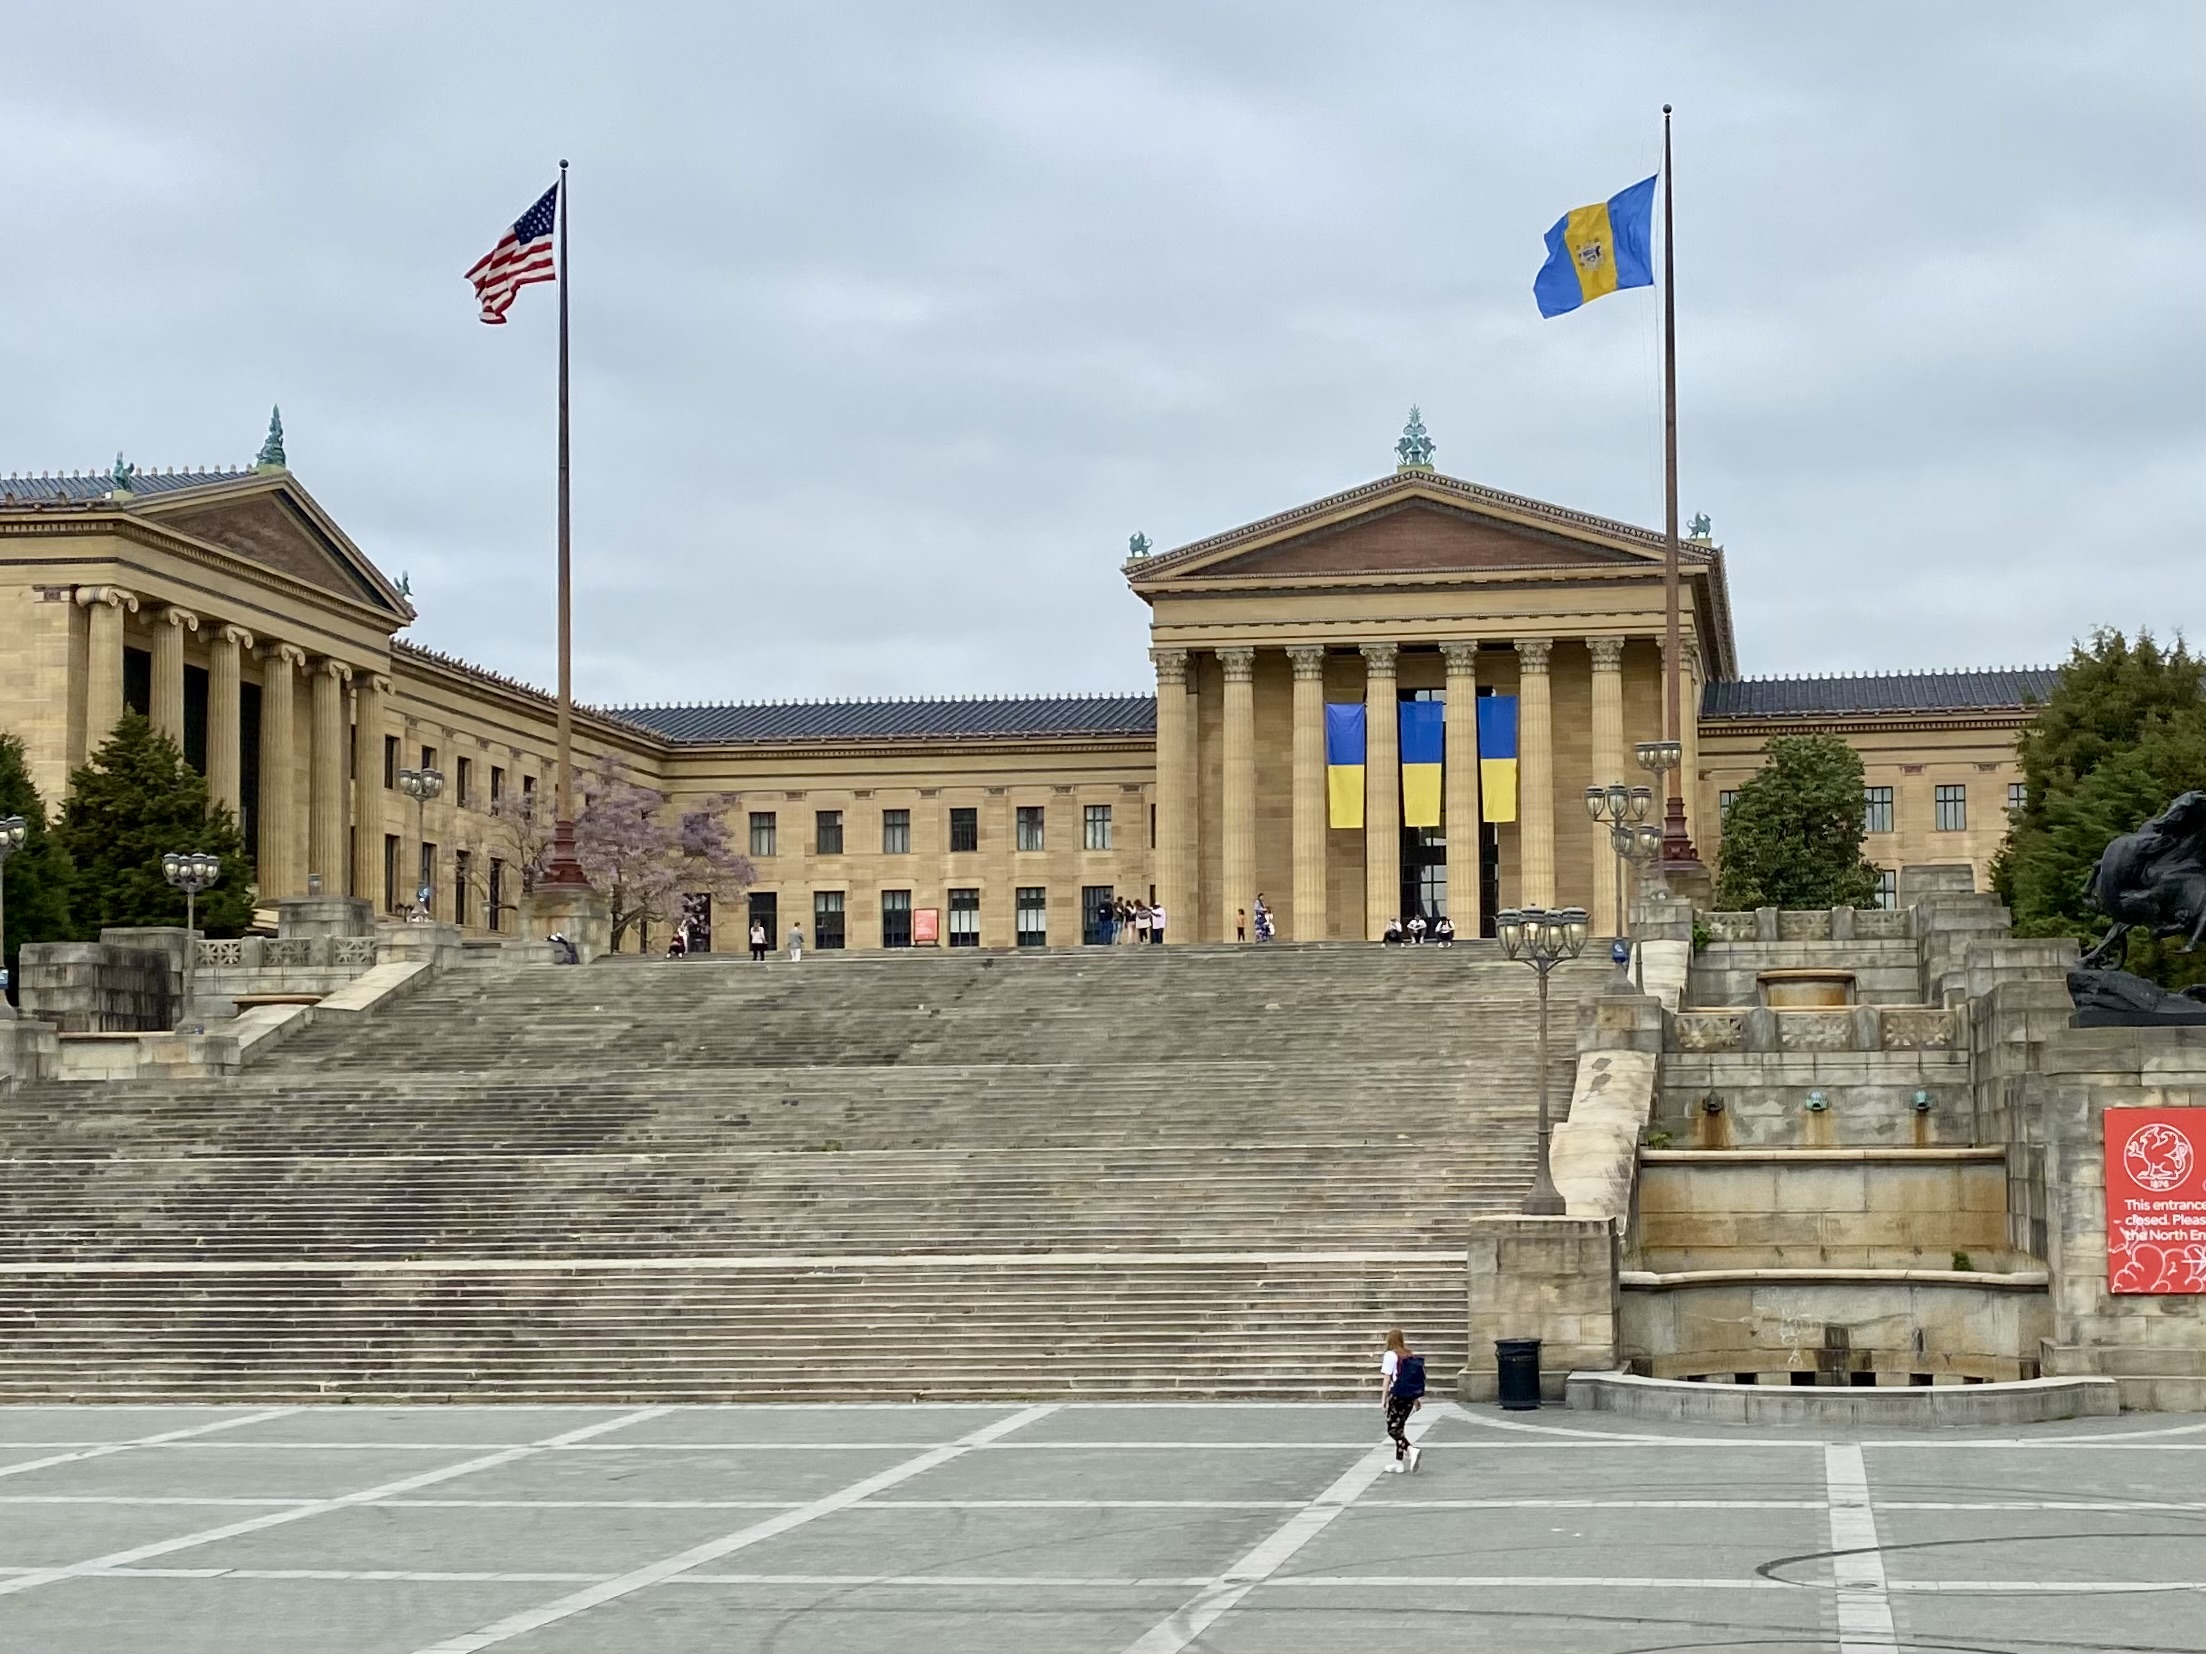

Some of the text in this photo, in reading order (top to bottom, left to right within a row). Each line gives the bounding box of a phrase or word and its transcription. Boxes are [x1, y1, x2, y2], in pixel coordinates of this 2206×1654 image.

[2150, 1180, 2169, 1189] 1876
[2124, 1198, 2151, 1211] This
[2125, 1213, 2171, 1226] closed.
[2149, 1229, 2189, 1241] North
